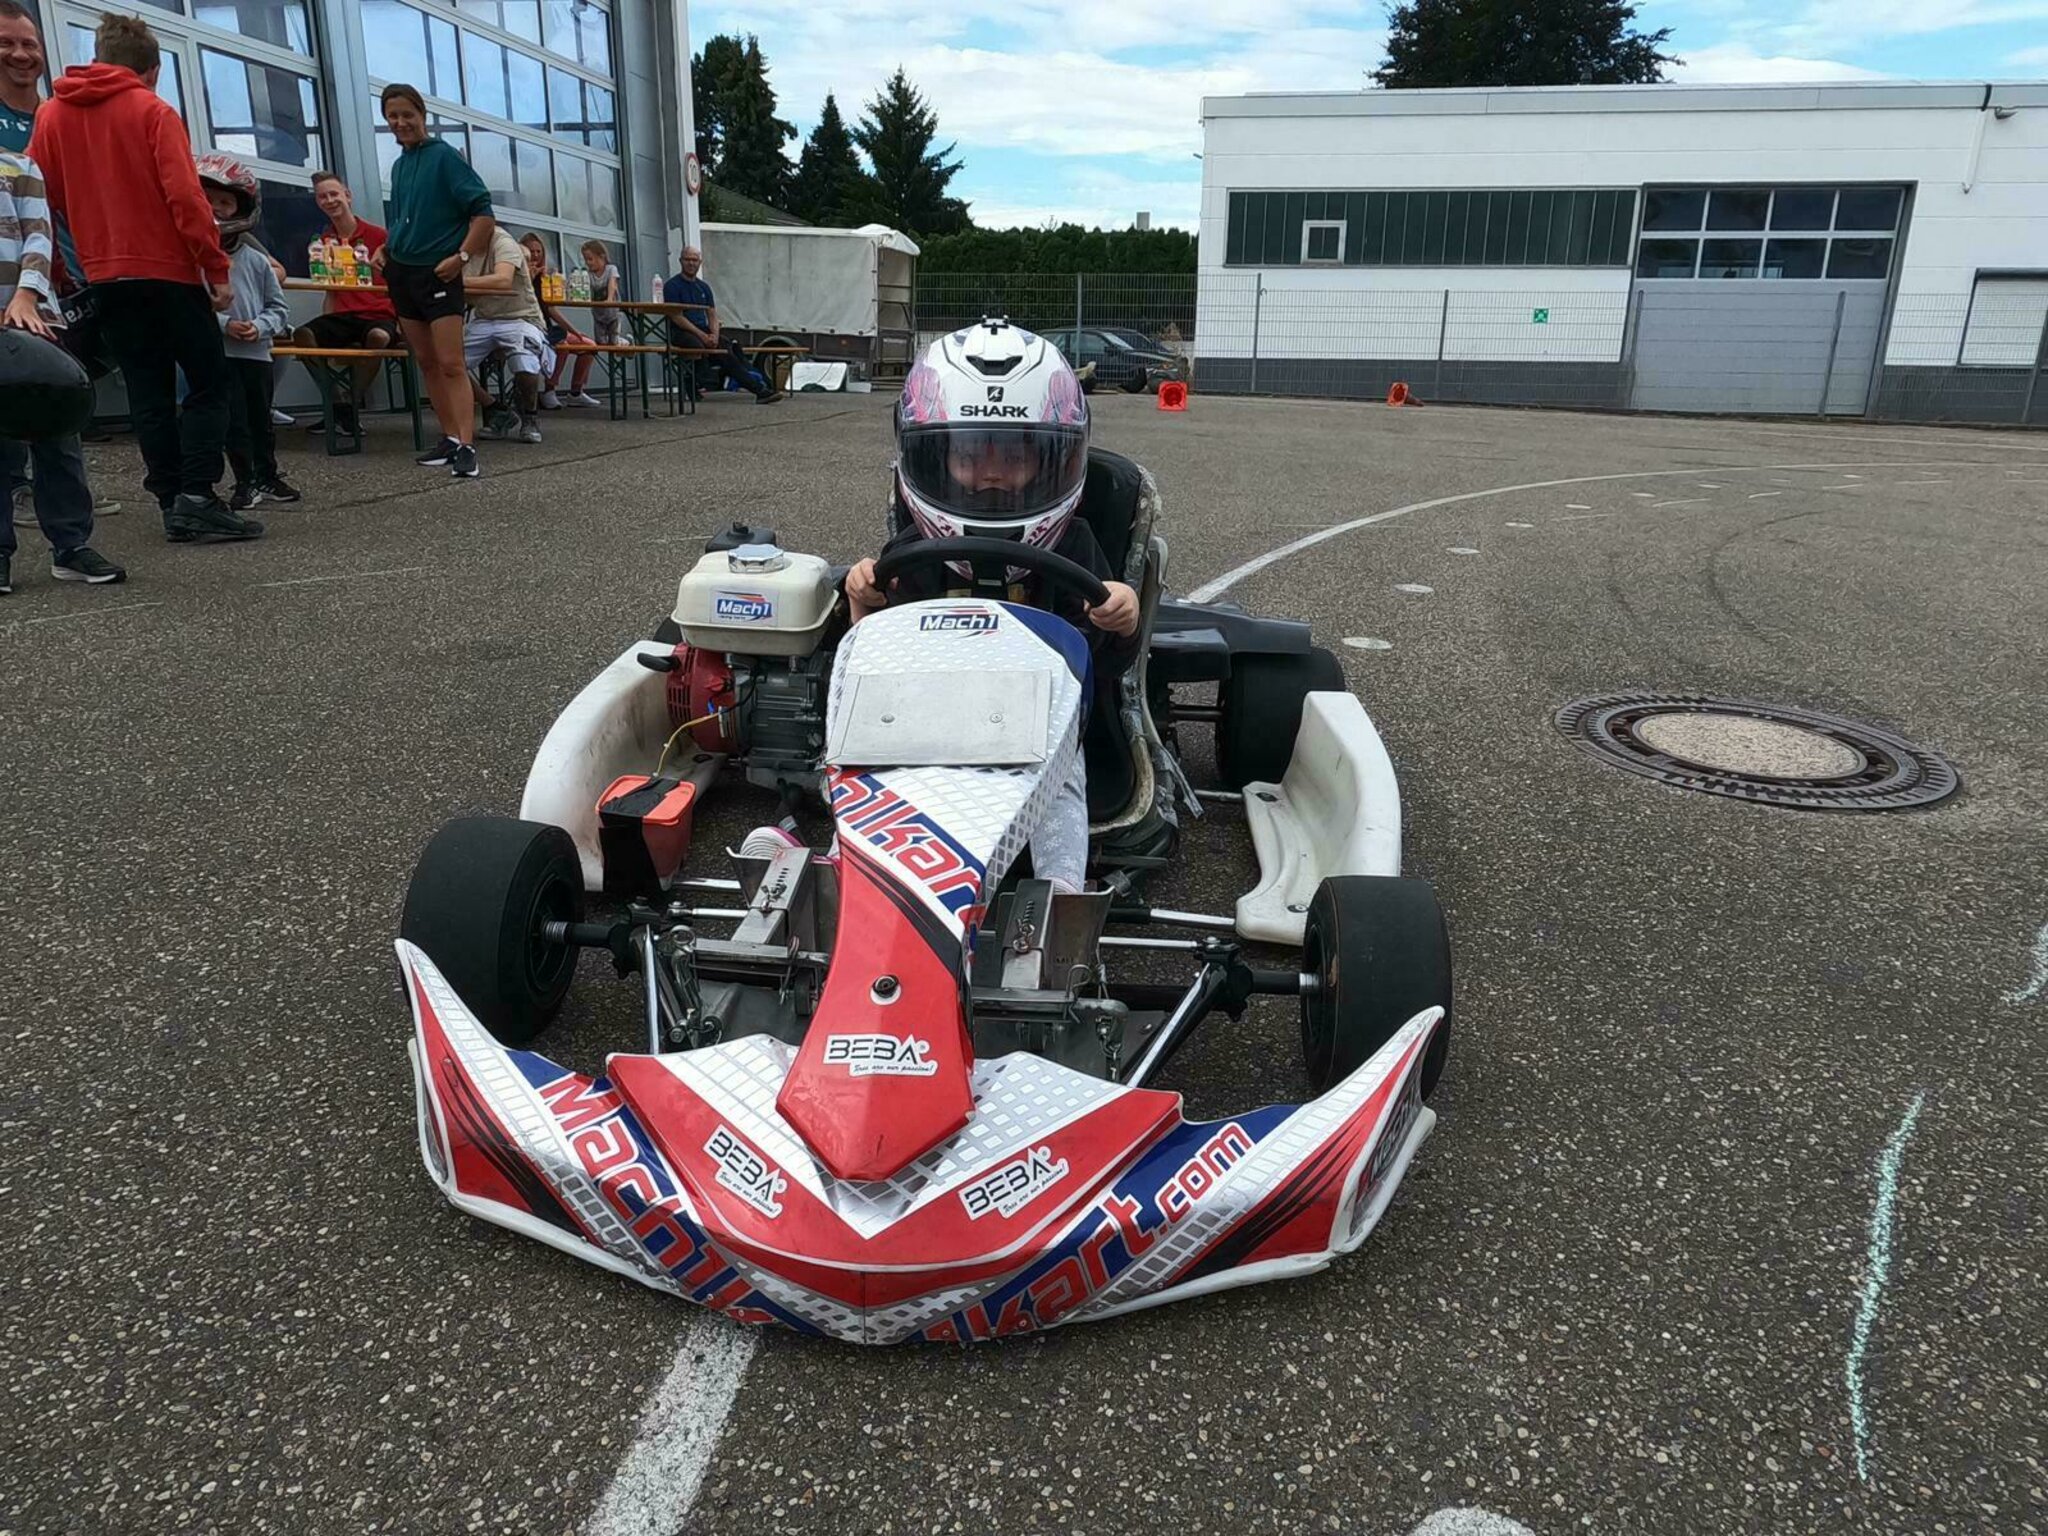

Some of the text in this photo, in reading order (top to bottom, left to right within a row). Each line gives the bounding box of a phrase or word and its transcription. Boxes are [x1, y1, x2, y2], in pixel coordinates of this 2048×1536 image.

[960, 404, 1029, 418] SHARK
[719, 600, 769, 616] Mach1
[922, 614, 997, 630] Mach1
[828, 1038, 918, 1065] BEBA
[708, 1130, 774, 1202] BEBA
[963, 1157, 1051, 1214] BEBA
